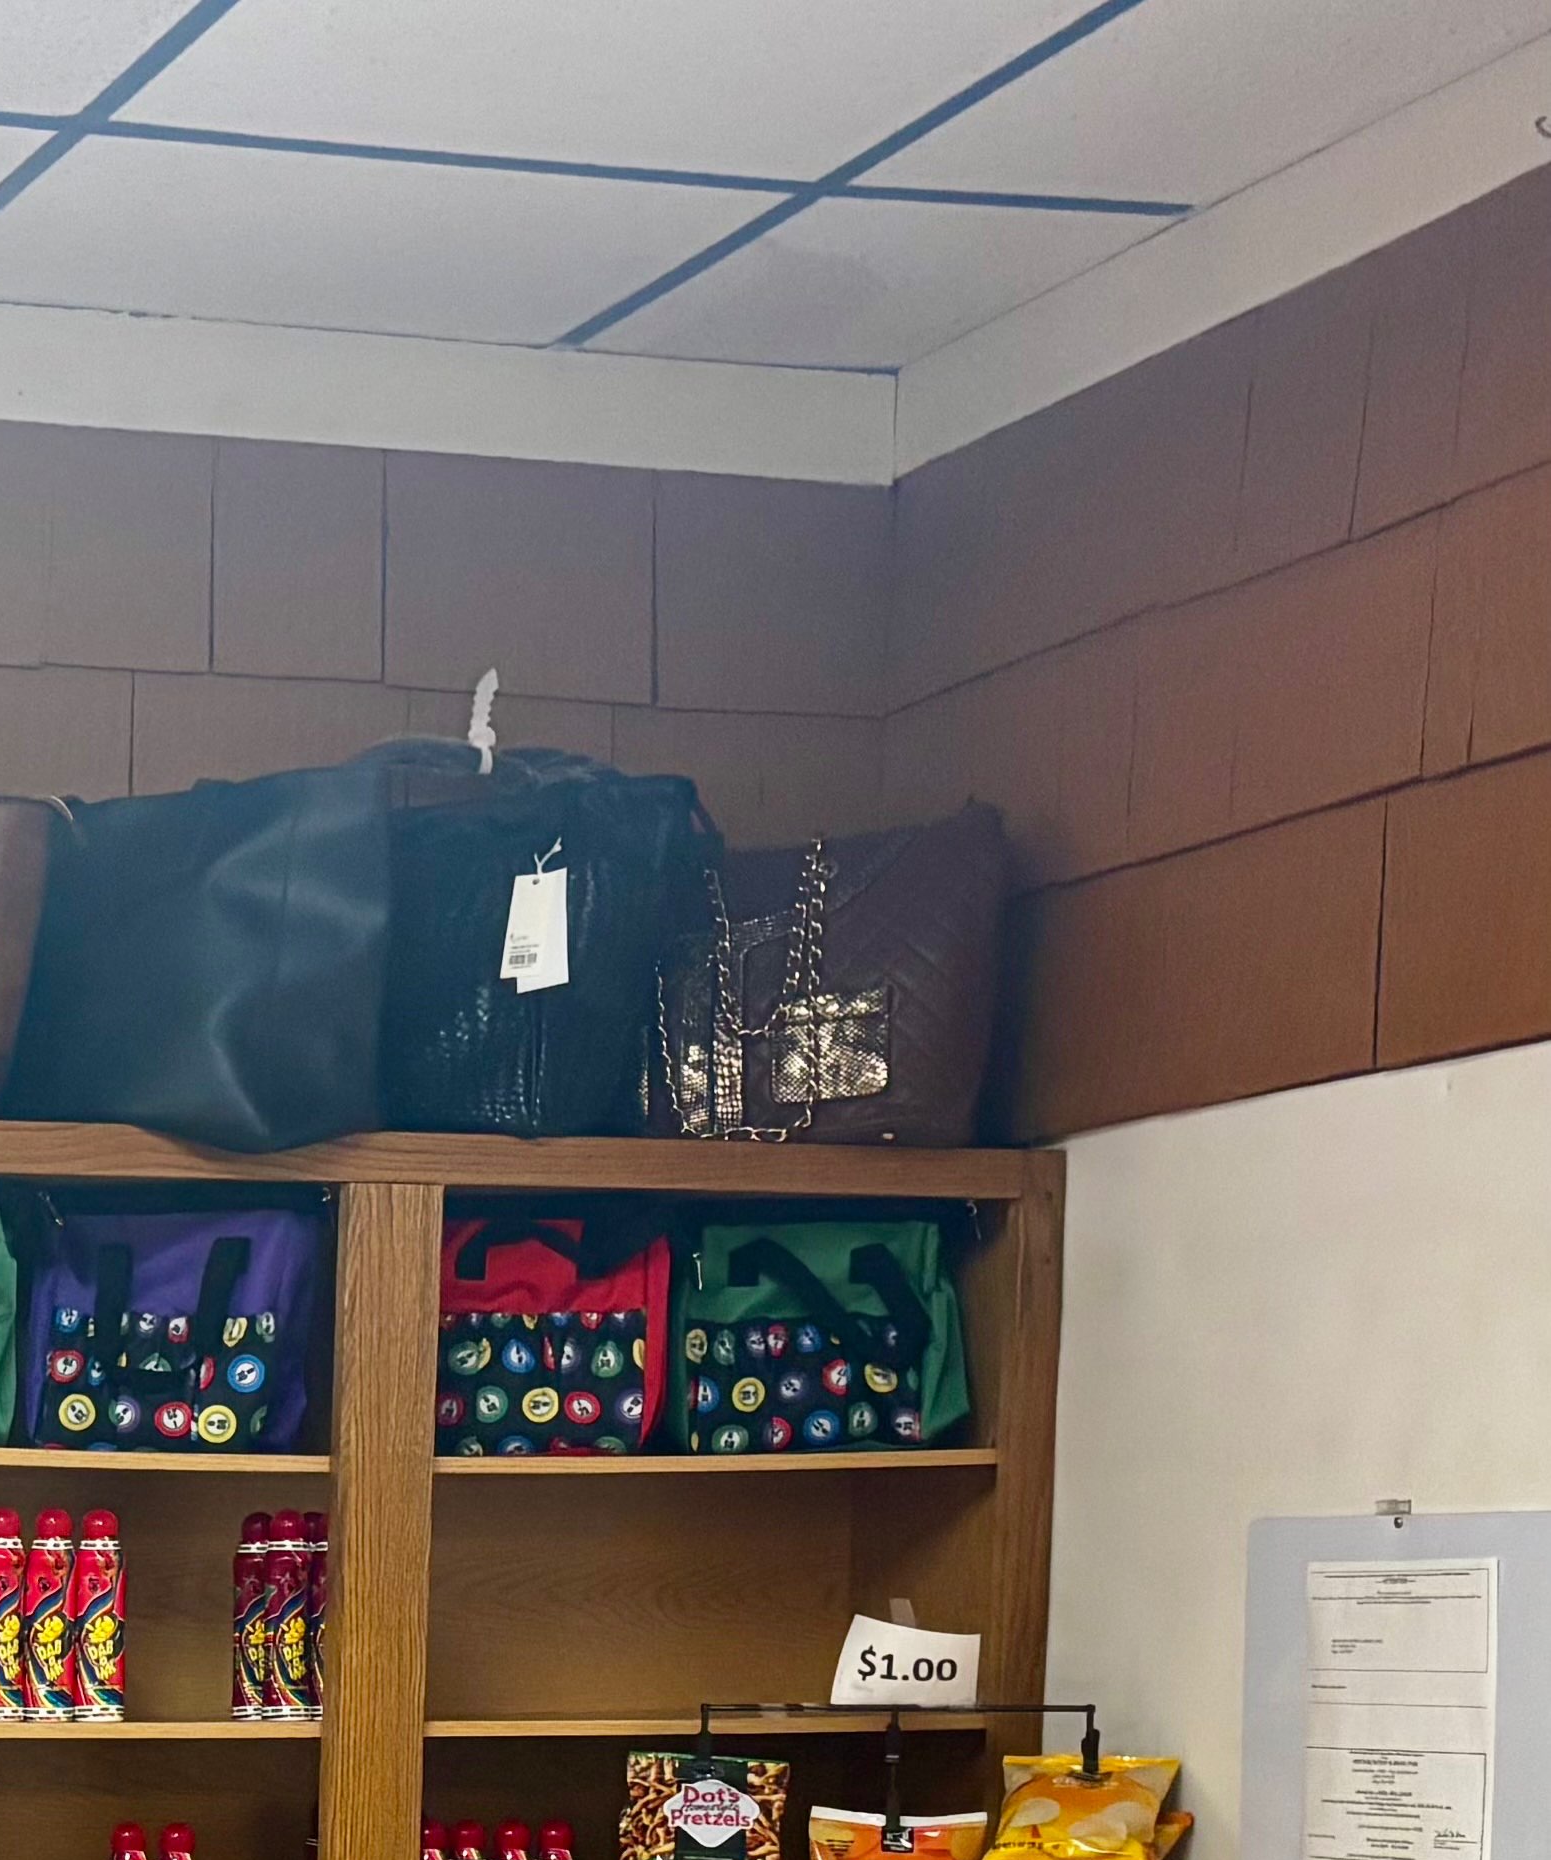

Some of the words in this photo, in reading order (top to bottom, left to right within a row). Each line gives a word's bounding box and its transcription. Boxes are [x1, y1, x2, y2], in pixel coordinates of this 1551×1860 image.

[37, 1639, 62, 1659] DAB
[88, 1640, 113, 1660] DAB
[857, 1644, 957, 1682] $1.00
[683, 1786, 740, 1803] Dot's
[670, 1808, 751, 1827] Pretzels
